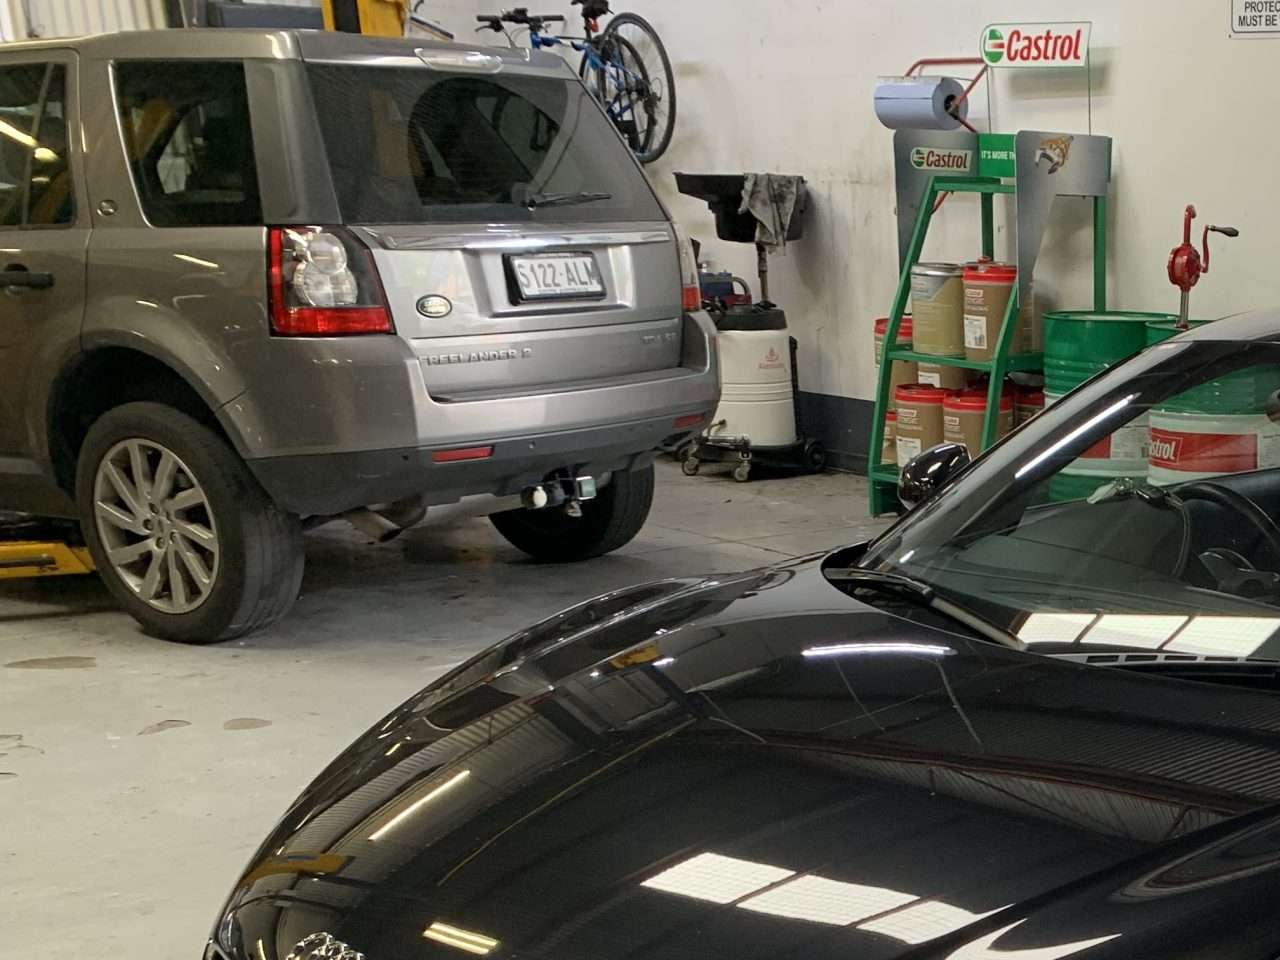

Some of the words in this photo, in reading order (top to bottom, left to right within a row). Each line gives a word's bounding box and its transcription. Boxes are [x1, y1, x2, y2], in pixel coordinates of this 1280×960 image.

[1238, 15, 1262, 27] MUST
[1264, 14, 1278, 26] BE
[1006, 29, 1081, 61] Castrol
[926, 150, 968, 168] Castrol
[418, 349, 517, 365] FREELANDER
[521, 347, 532, 359] 2
[1149, 438, 1176, 460] strol
